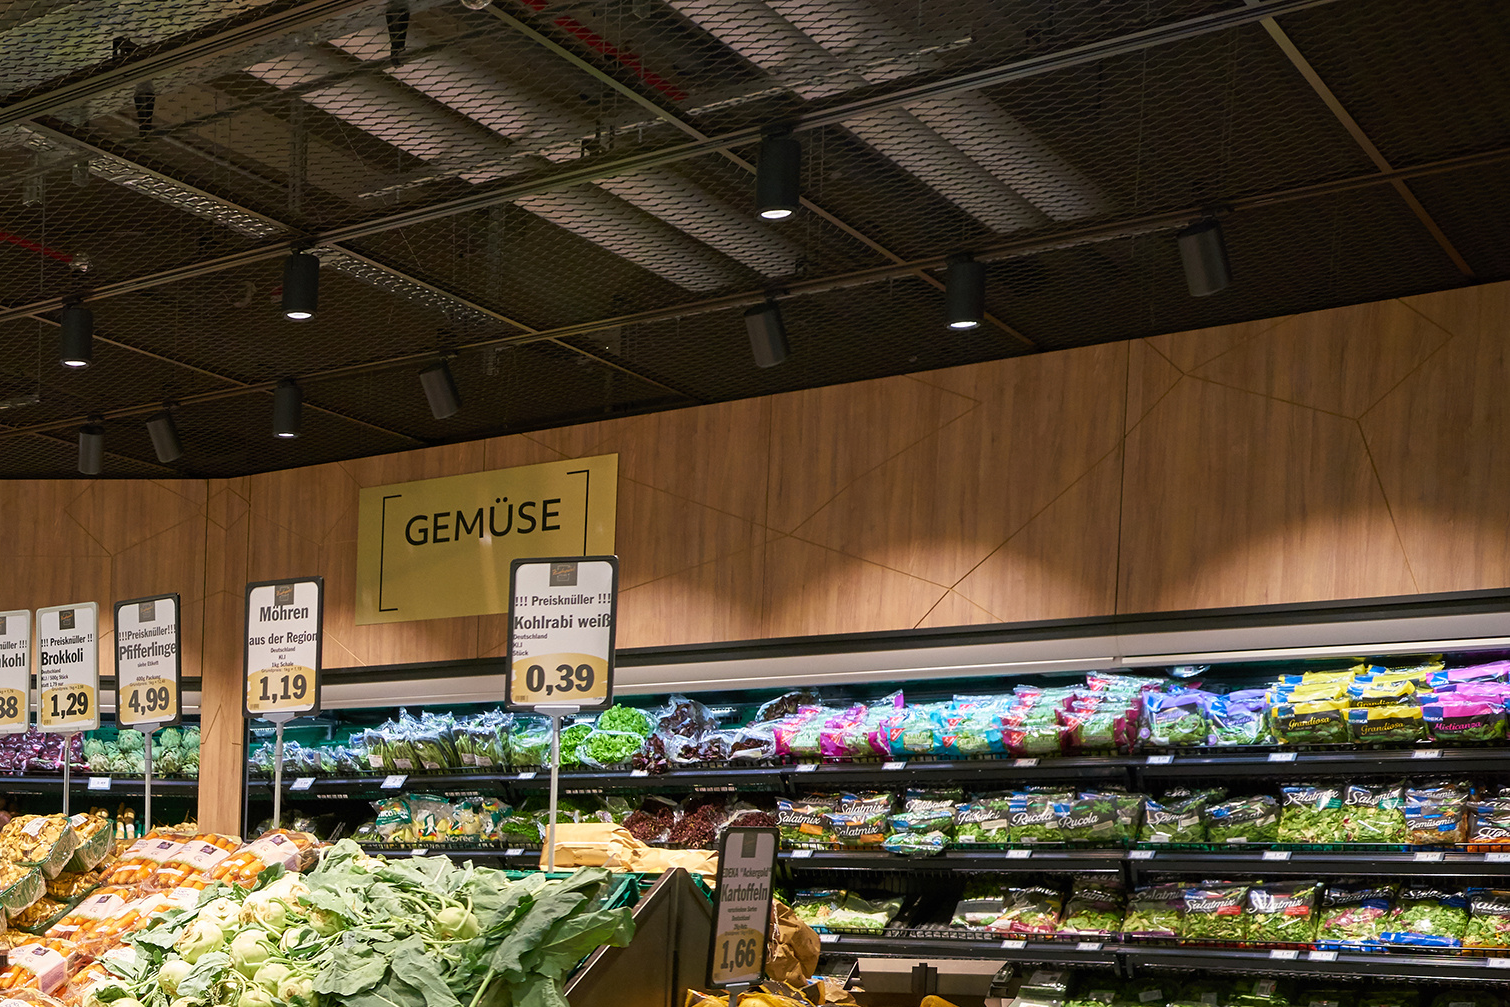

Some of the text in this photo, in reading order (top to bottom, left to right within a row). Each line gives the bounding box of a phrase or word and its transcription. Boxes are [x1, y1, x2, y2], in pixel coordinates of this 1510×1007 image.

[404, 496, 561, 546] GEMÜSE
[531, 594, 594, 606] Preisknüller
[259, 604, 309, 622] Möhren
[514, 613, 611, 630] Kohlrabi weiß
[50, 635, 86, 647] Preisknüller
[249, 631, 318, 646] aus der Region
[41, 647, 84, 666] Brokkoli
[119, 641, 177, 660] Pfifferlinge
[526, 664, 595, 696] 0,39
[259, 674, 307, 704] 1,19
[50, 692, 89, 719] 1,29
[128, 686, 170, 715] 4,99
[1288, 715, 1331, 731] Grandiosa
[1361, 721, 1404, 735] Grandiosa
[1433, 720, 1482, 731] Misticanza
[776, 810, 821, 825] Salatmix
[1011, 812, 1054, 826] Rucola
[1058, 813, 1099, 829] Rucola
[1407, 817, 1456, 830] Gemüsemix
[834, 822, 879, 836] Salatmix
[722, 867, 739, 879] EDEKA
[721, 883, 768, 902] Kartoffeln
[1185, 898, 1235, 914] Salatmix
[720, 938, 756, 972] 1,66
